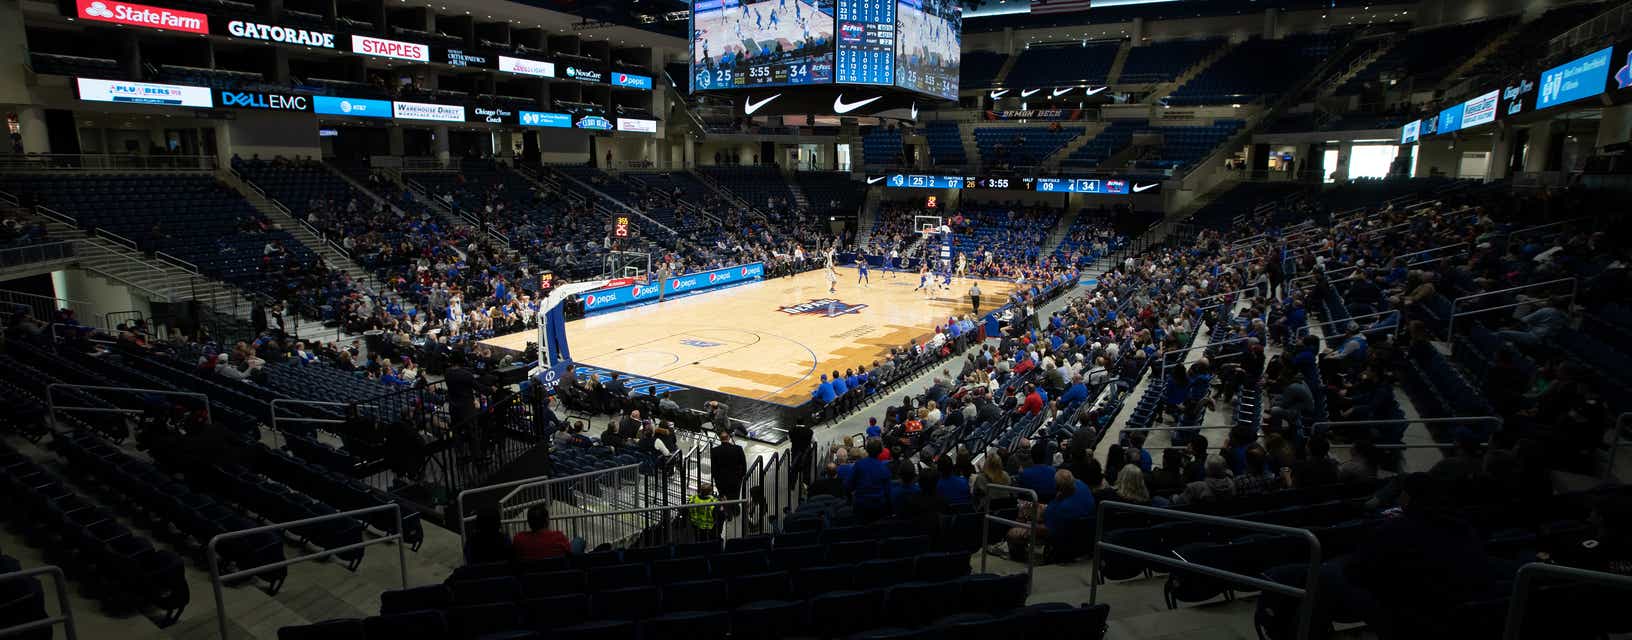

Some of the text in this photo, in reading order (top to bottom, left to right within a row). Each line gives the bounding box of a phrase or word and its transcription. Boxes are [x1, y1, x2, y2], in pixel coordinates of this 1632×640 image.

[228, 20, 335, 48] GATORADE
[362, 39, 421, 59] STAPLES
[716, 70, 732, 81] 25
[749, 66, 770, 77] 3:55
[790, 64, 808, 77] 34
[913, 177, 924, 185] 25
[948, 180, 958, 188] 07
[988, 179, 1009, 188] 3:55
[1043, 183, 1054, 191] 09
[1082, 182, 1094, 191] 34
[716, 272, 731, 281] pepsi
[680, 279, 696, 288] pepsi
[641, 286, 659, 296] pepsi
[596, 293, 616, 304] pepsi
